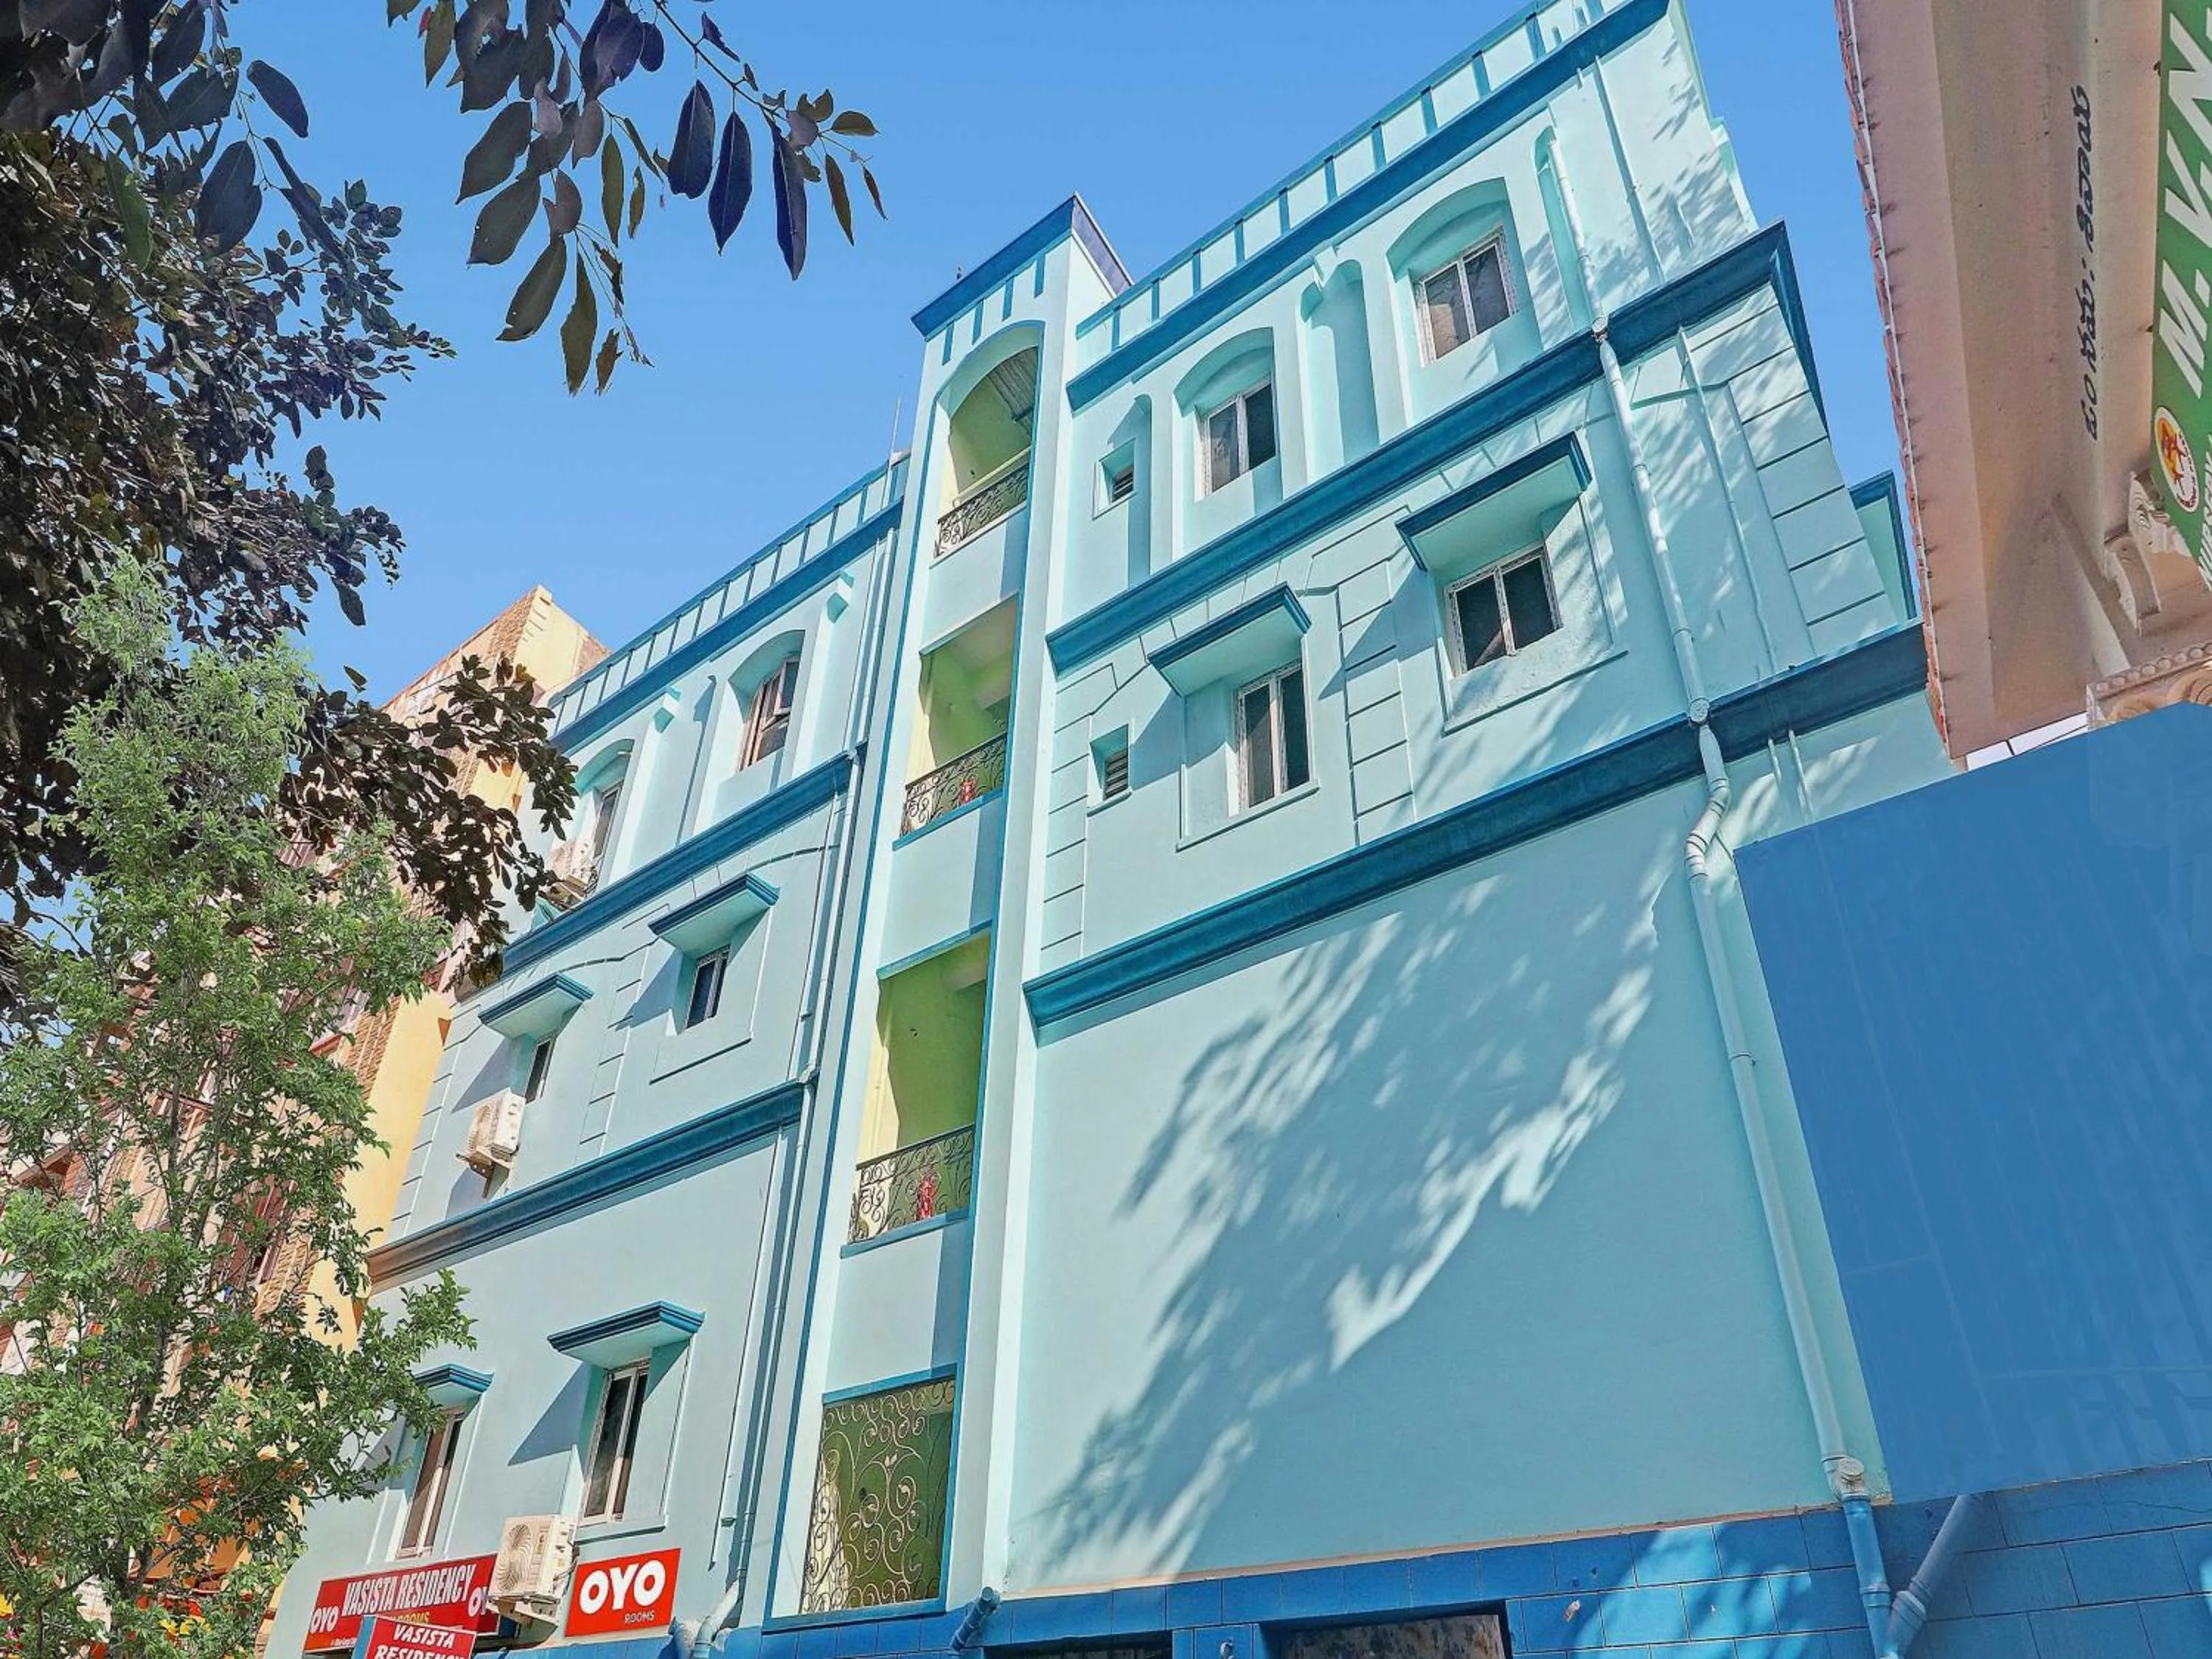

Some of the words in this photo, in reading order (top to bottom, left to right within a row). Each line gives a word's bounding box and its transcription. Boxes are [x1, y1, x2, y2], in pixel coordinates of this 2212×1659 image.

[341, 1576, 398, 1616] VASISTA
[395, 1563, 476, 1609] RESIDENCY
[467, 1586, 487, 1617] OY
[580, 1559, 666, 1615] OYO
[310, 1605, 338, 1634] OYO
[625, 1610, 655, 1624] ROOMS
[393, 1624, 455, 1649] VASISTA
